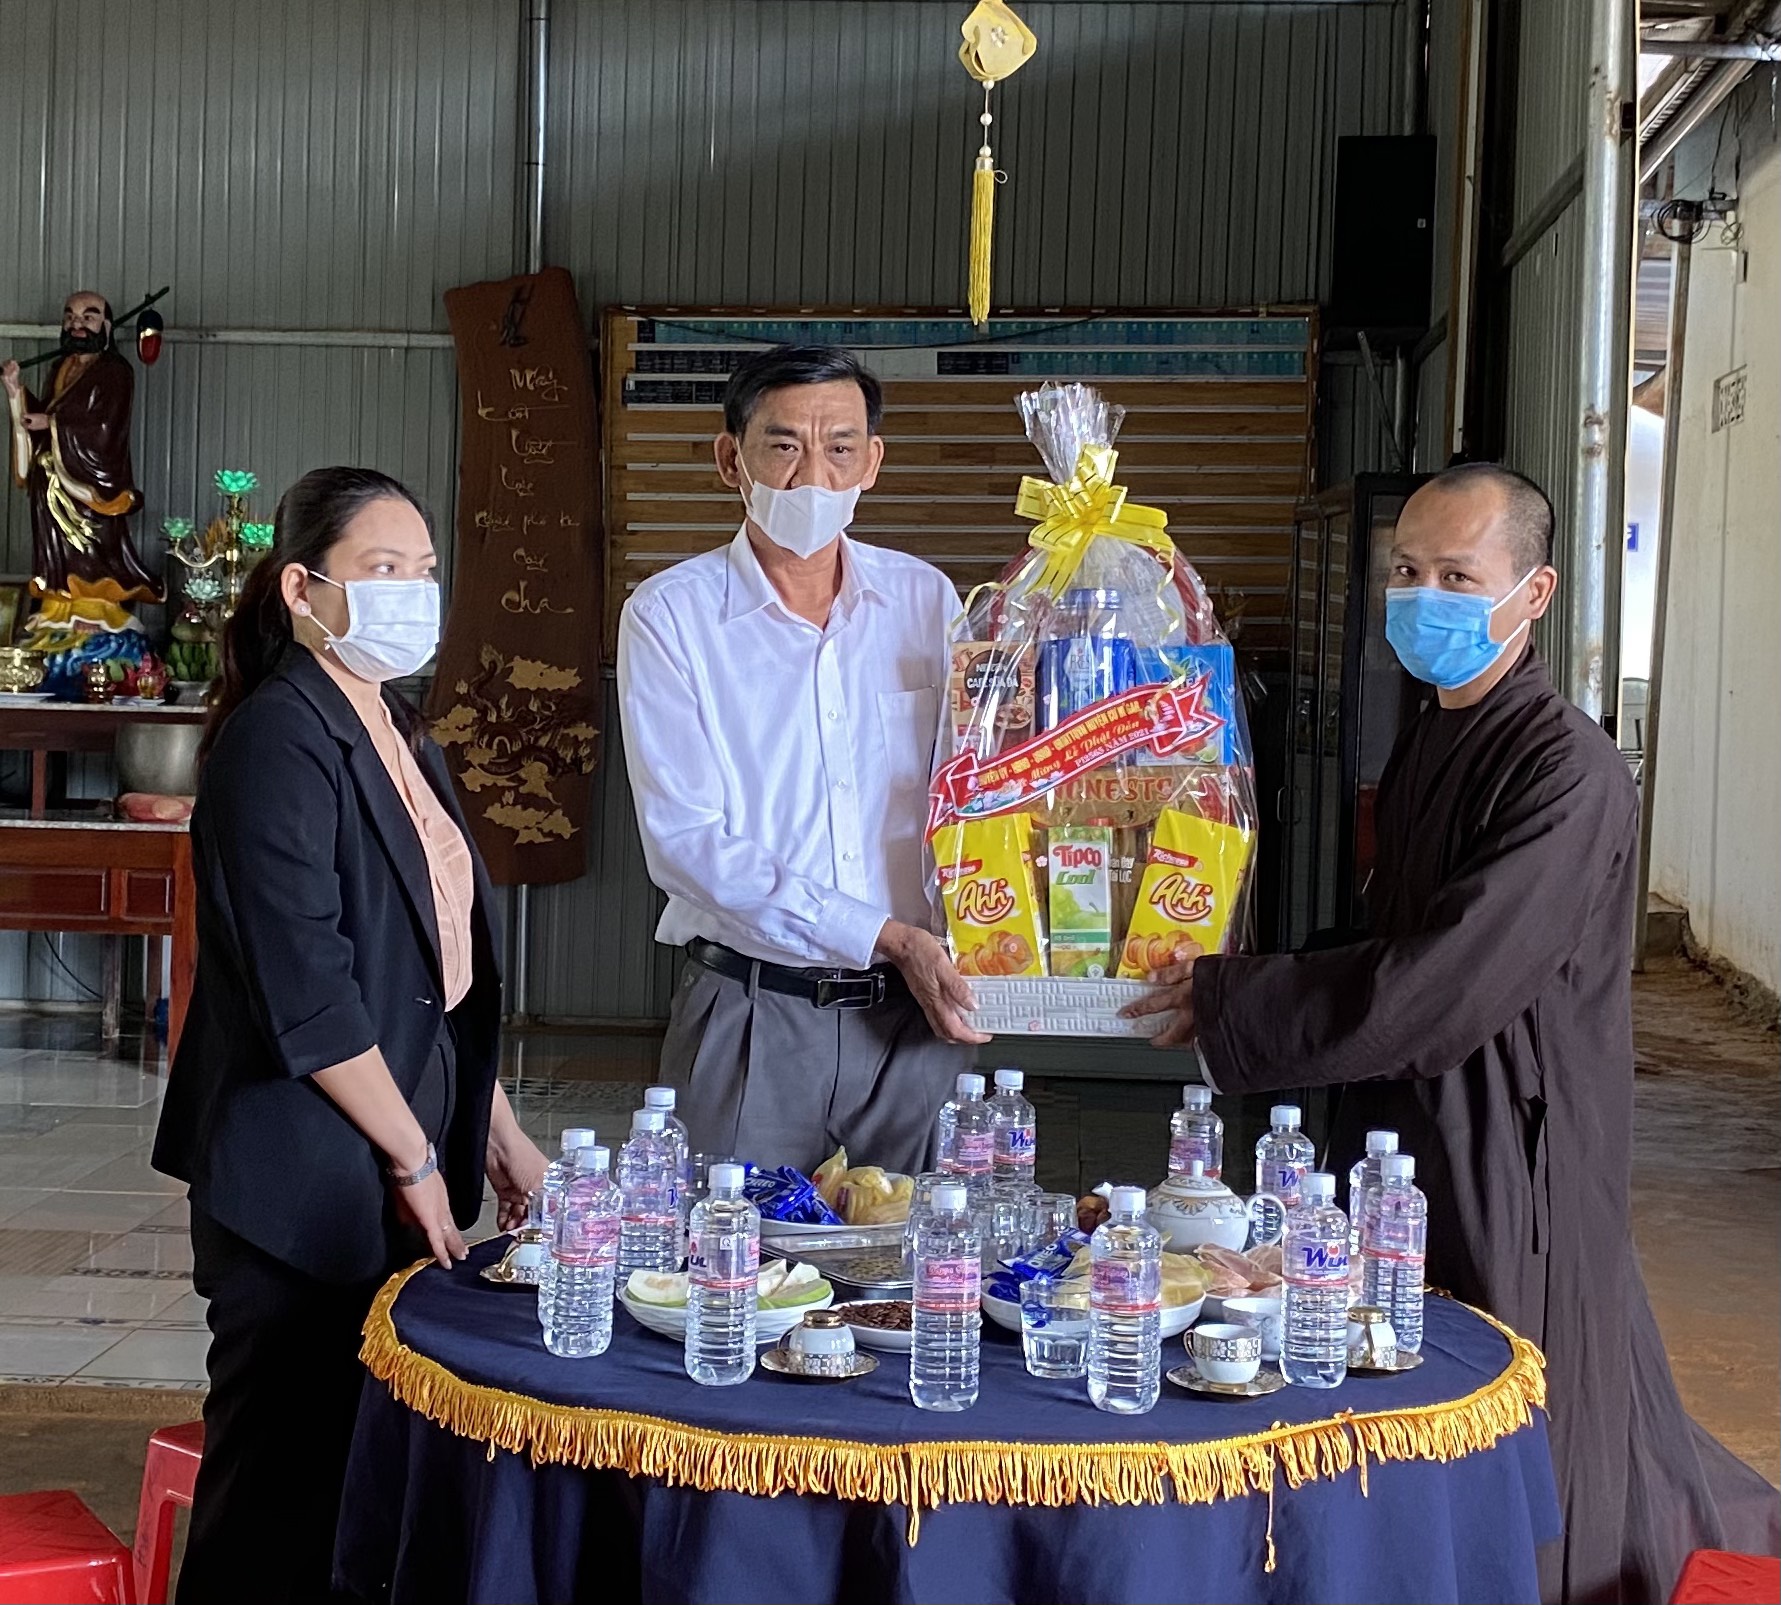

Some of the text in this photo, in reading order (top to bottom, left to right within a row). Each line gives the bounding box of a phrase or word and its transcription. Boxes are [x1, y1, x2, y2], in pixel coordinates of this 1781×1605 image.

[1128, 727, 1150, 740] 2021
[1056, 869, 1097, 885] Cool
[1029, 1243, 1058, 1268] OREO
